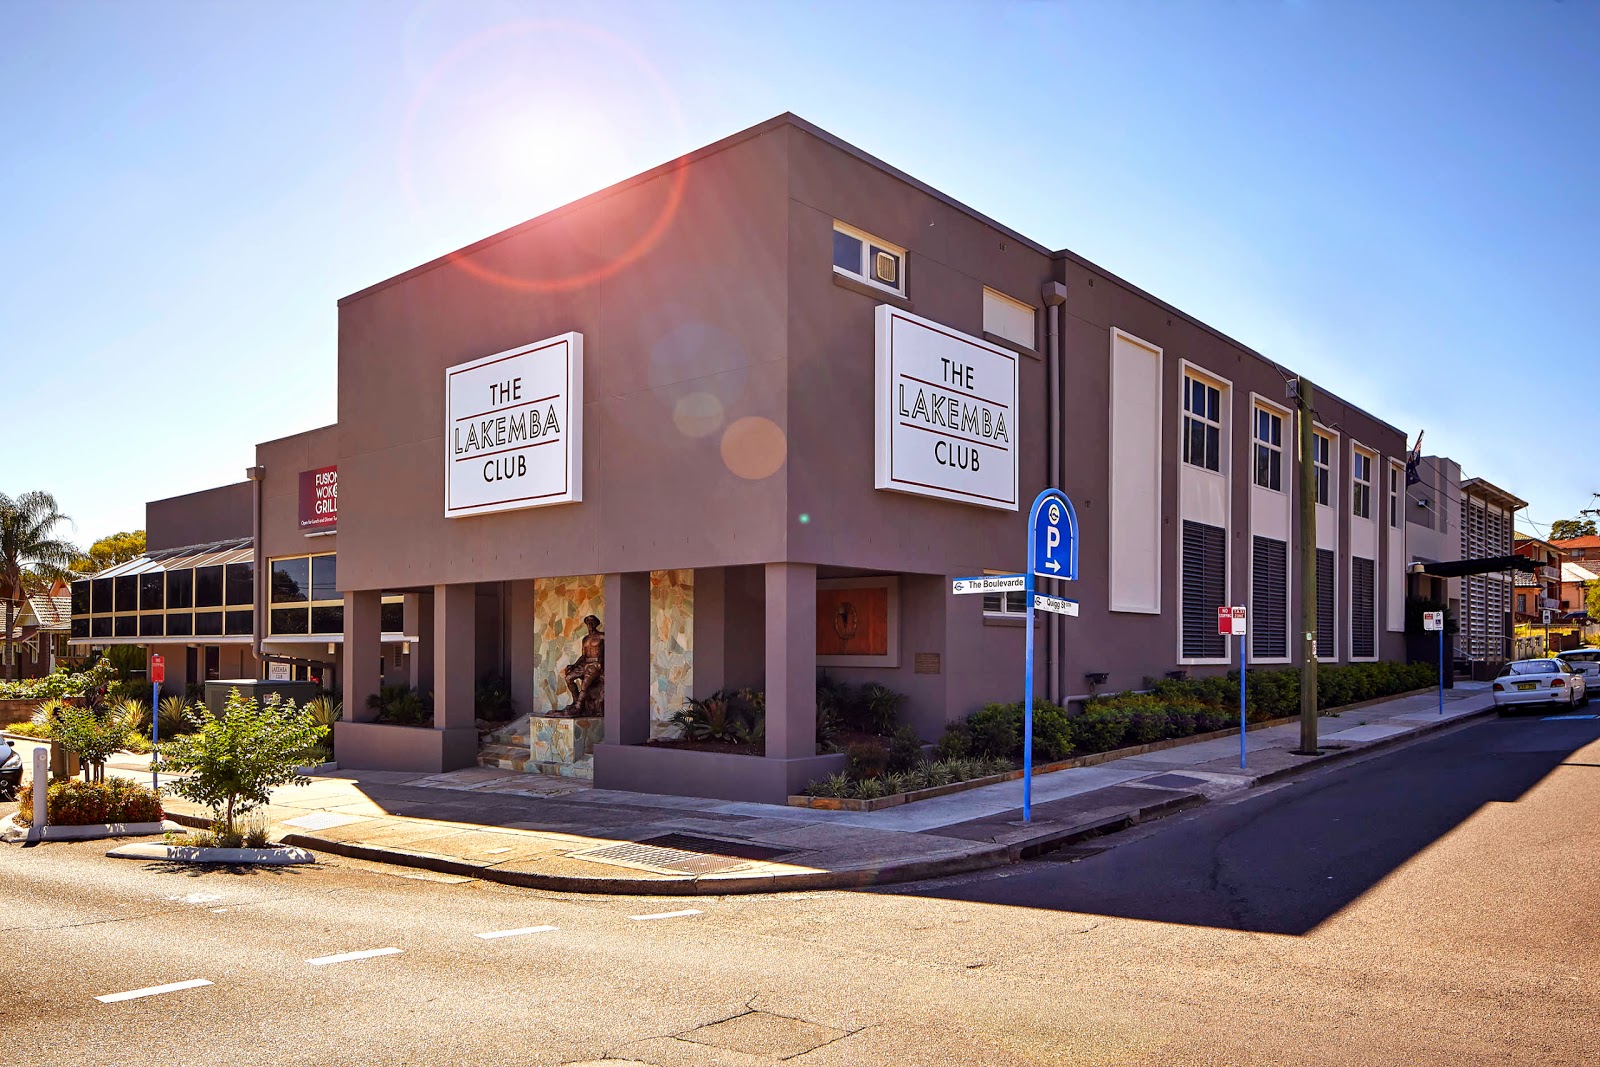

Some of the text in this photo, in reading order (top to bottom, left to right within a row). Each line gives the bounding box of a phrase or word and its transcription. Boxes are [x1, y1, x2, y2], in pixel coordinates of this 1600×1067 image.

[940, 357, 974, 390] THE
[489, 377, 522, 406] THE
[454, 404, 561, 455] LAKEMBA
[899, 384, 1009, 443] LAKEMBA
[483, 454, 527, 483] CLUB
[934, 440, 980, 472] CLUB
[1046, 525, 1060, 559] P
[968, 578, 1024, 589] The Boulevarde
[1046, 598, 1060, 610] Quigg
[1061, 600, 1066, 609] St
